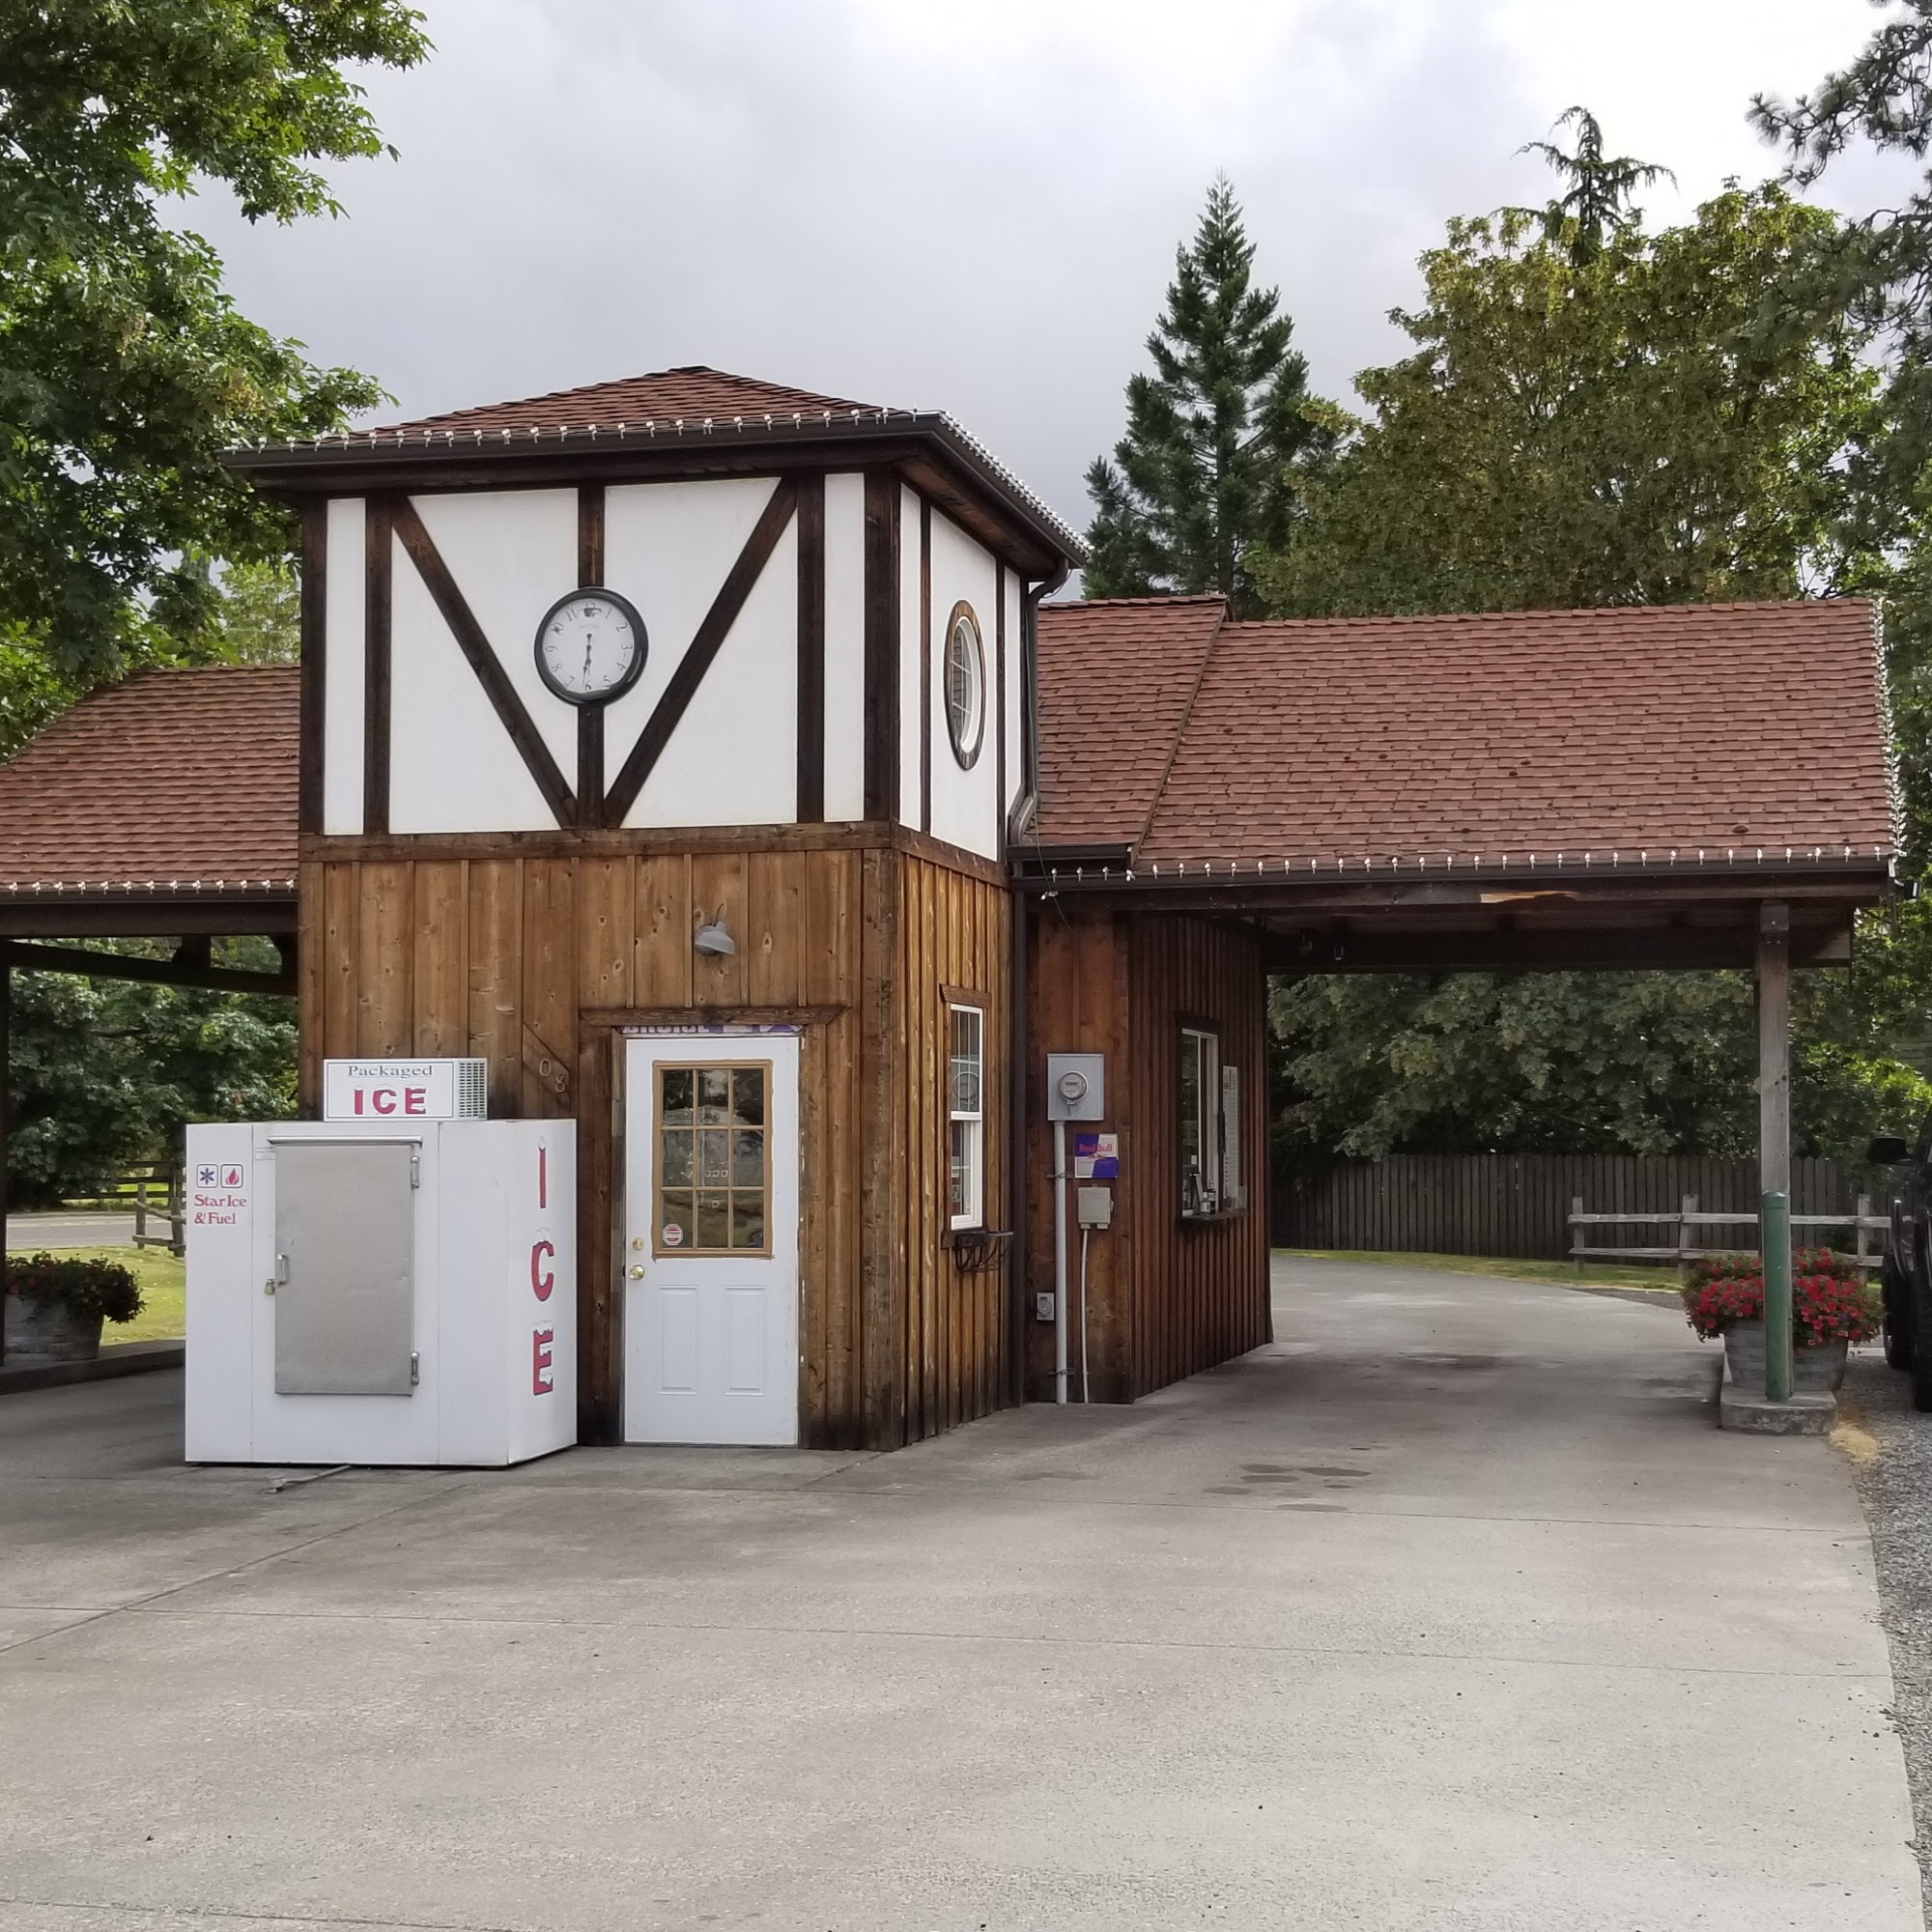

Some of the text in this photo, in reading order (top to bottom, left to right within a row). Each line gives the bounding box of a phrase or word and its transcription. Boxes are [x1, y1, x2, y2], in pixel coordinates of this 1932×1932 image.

[348, 1065, 433, 1079] Packaged
[354, 1085, 427, 1116] ICE
[194, 1211, 236, 1225] & Fuel
[530, 1139, 555, 1396] ICE
